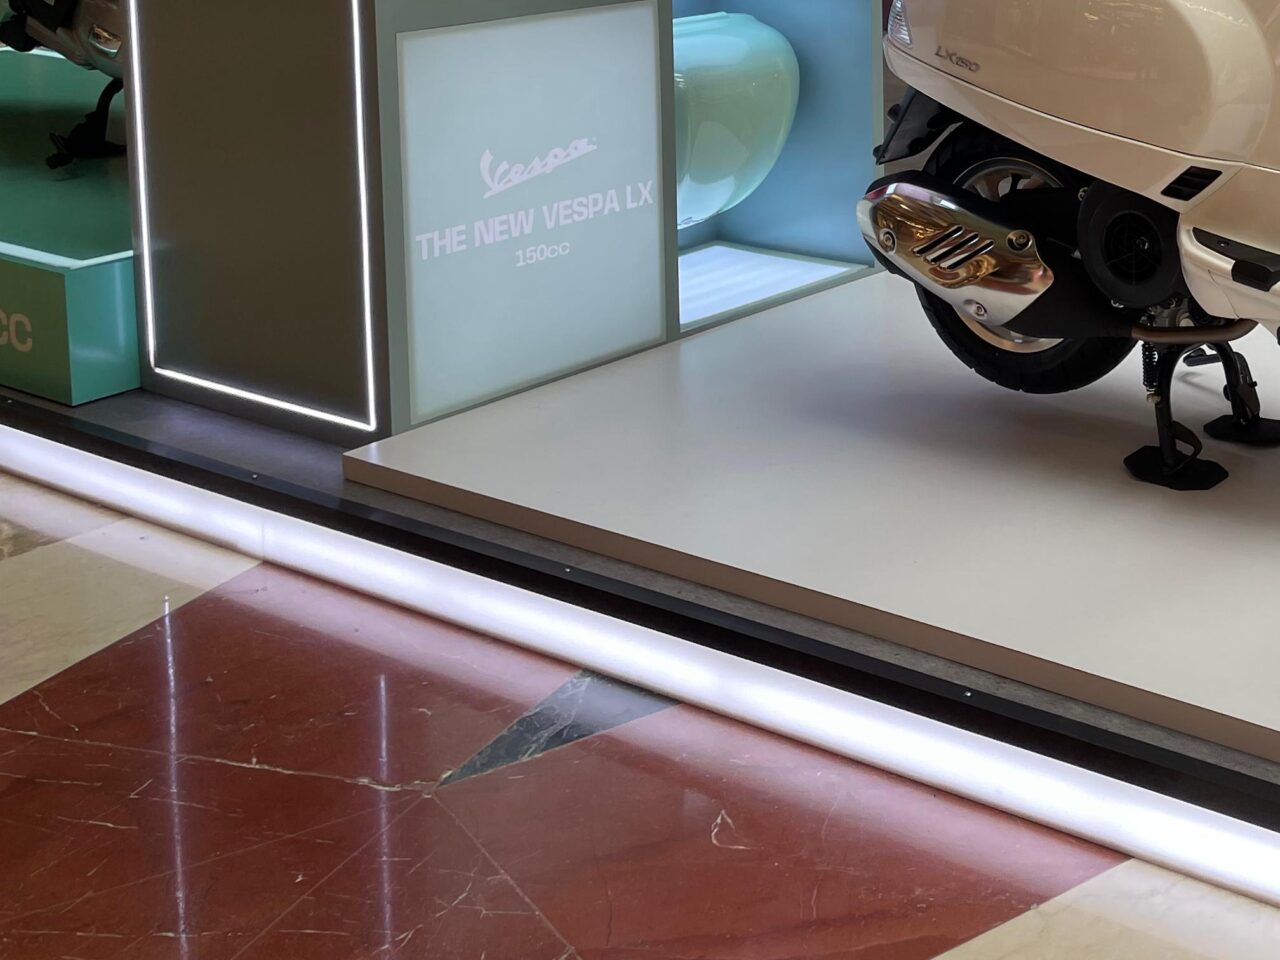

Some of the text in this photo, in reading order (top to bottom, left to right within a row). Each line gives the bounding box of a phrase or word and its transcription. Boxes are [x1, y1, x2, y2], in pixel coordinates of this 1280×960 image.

[480, 137, 598, 199] Vespa
[415, 180, 653, 260] THE NEW VESPA LX
[515, 242, 570, 267] 150cc
